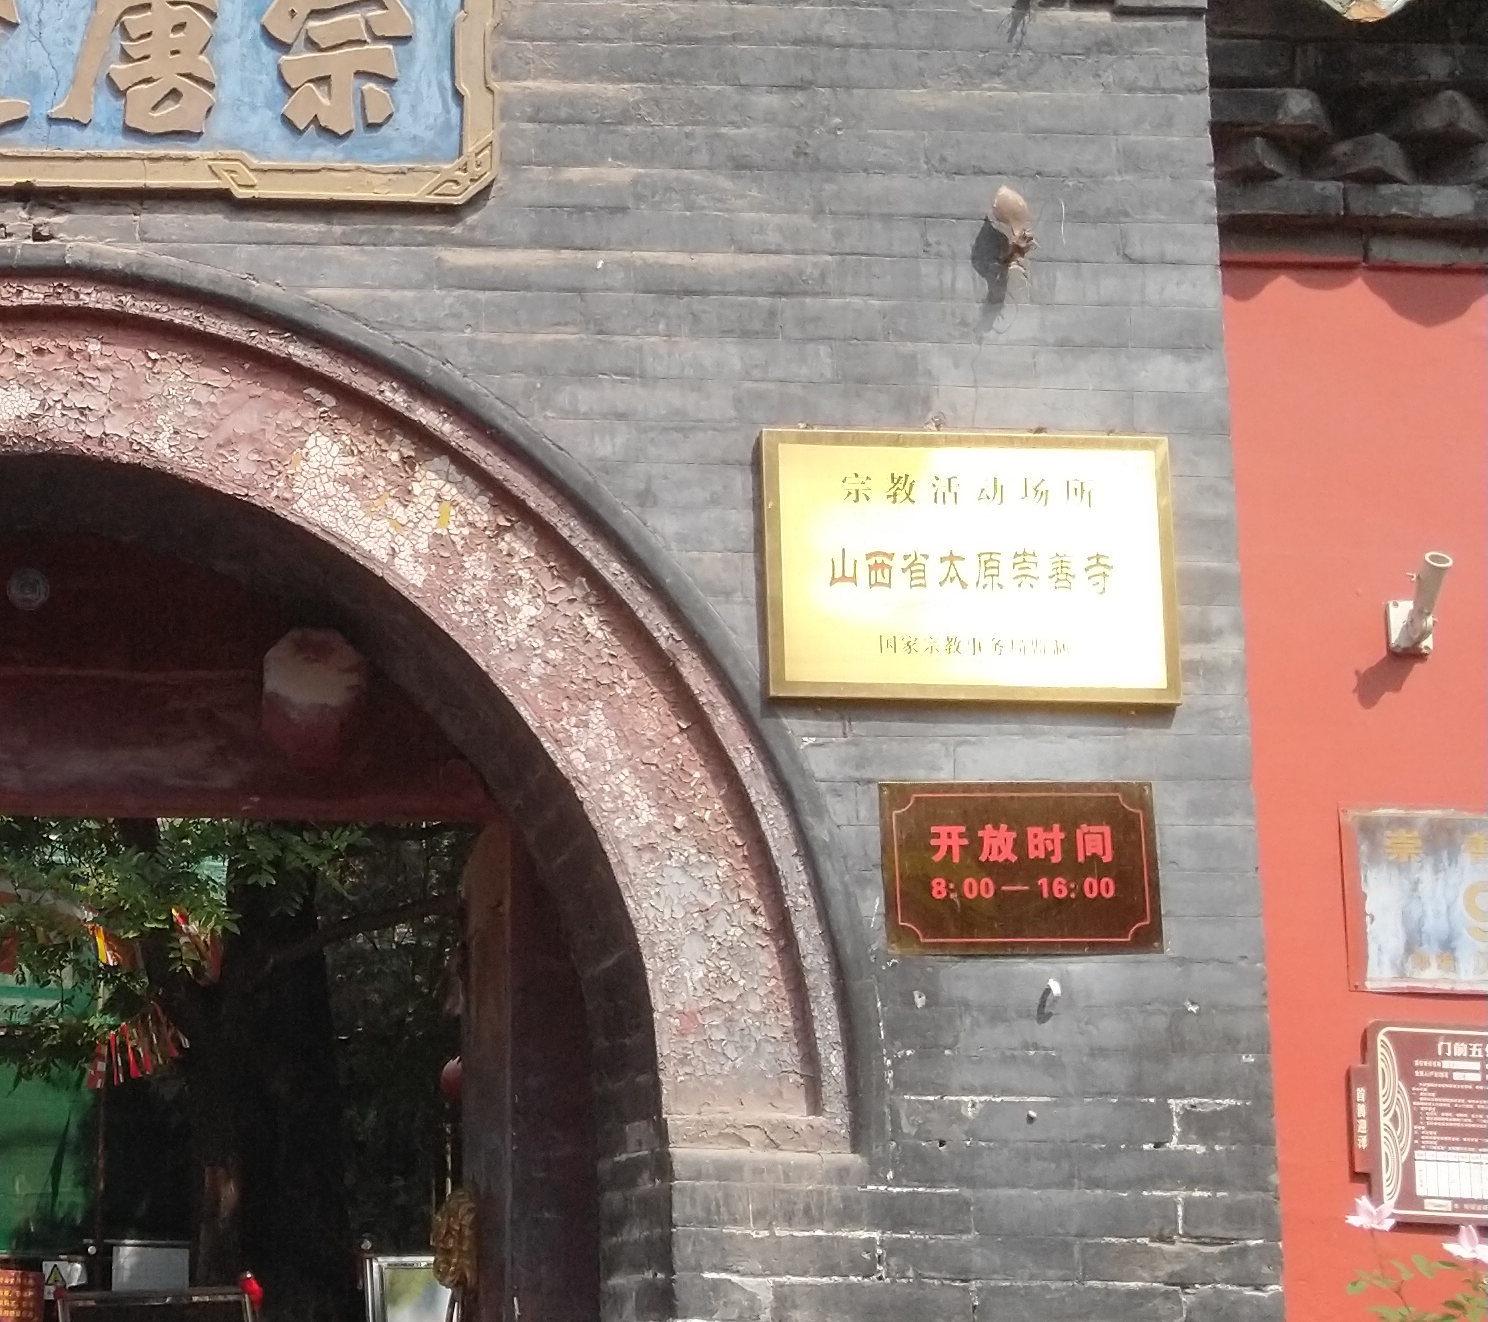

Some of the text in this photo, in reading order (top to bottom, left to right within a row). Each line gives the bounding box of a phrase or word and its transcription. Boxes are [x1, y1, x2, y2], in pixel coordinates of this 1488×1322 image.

[841, 472, 1096, 508] 宗教活动场所
[829, 547, 1114, 595] 山西省太原崇善寺
[930, 824, 1114, 864] 开放时间
[1437, 1041, 1488, 1058] 门前五
